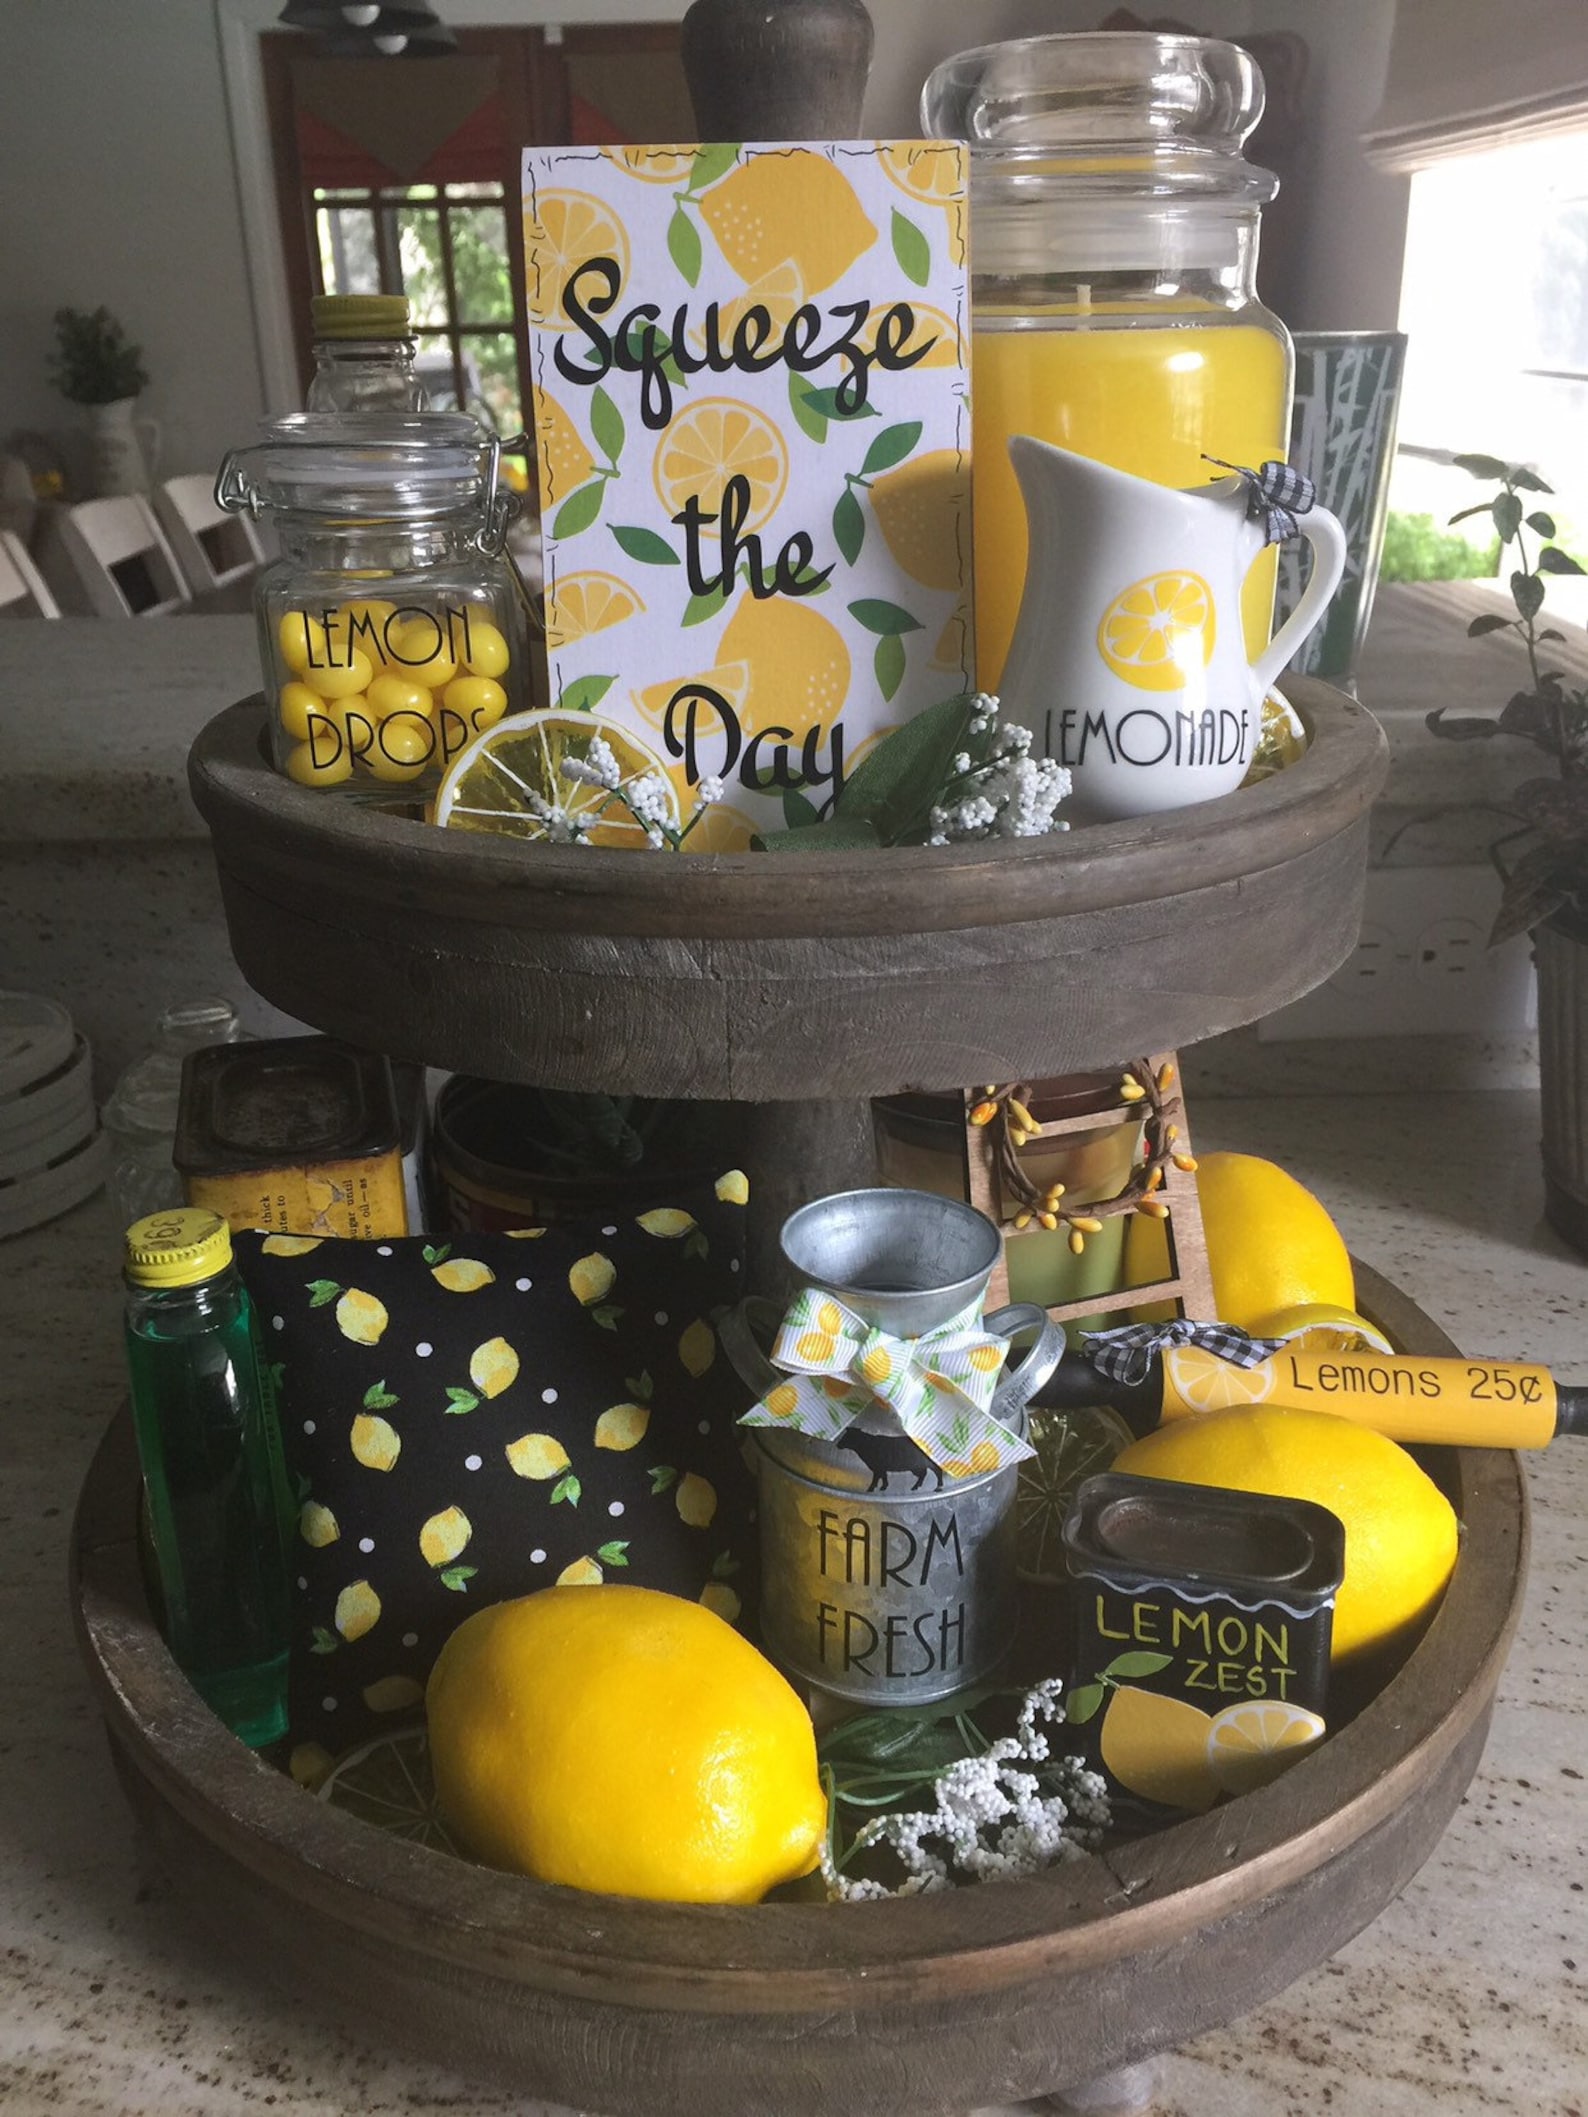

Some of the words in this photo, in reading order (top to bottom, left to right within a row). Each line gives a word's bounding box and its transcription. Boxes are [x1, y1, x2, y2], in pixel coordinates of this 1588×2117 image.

[554, 257, 939, 430] Squeeze
[671, 474, 837, 600] the
[302, 605, 473, 669] LEMON
[663, 683, 848, 823] Day
[1044, 709, 1249, 767] LEMONADE
[259, 1195, 272, 1223] thick
[277, 1195, 286, 1206] to
[342, 1179, 354, 1206] until
[1290, 1356, 1441, 1397] Lemons
[1467, 1367, 1542, 1405] 25¢
[817, 1510, 964, 1588] FARM
[816, 1602, 965, 1678] FRESH
[1096, 1595, 1288, 1665] LEMON
[1184, 1659, 1297, 1699] ZEST
